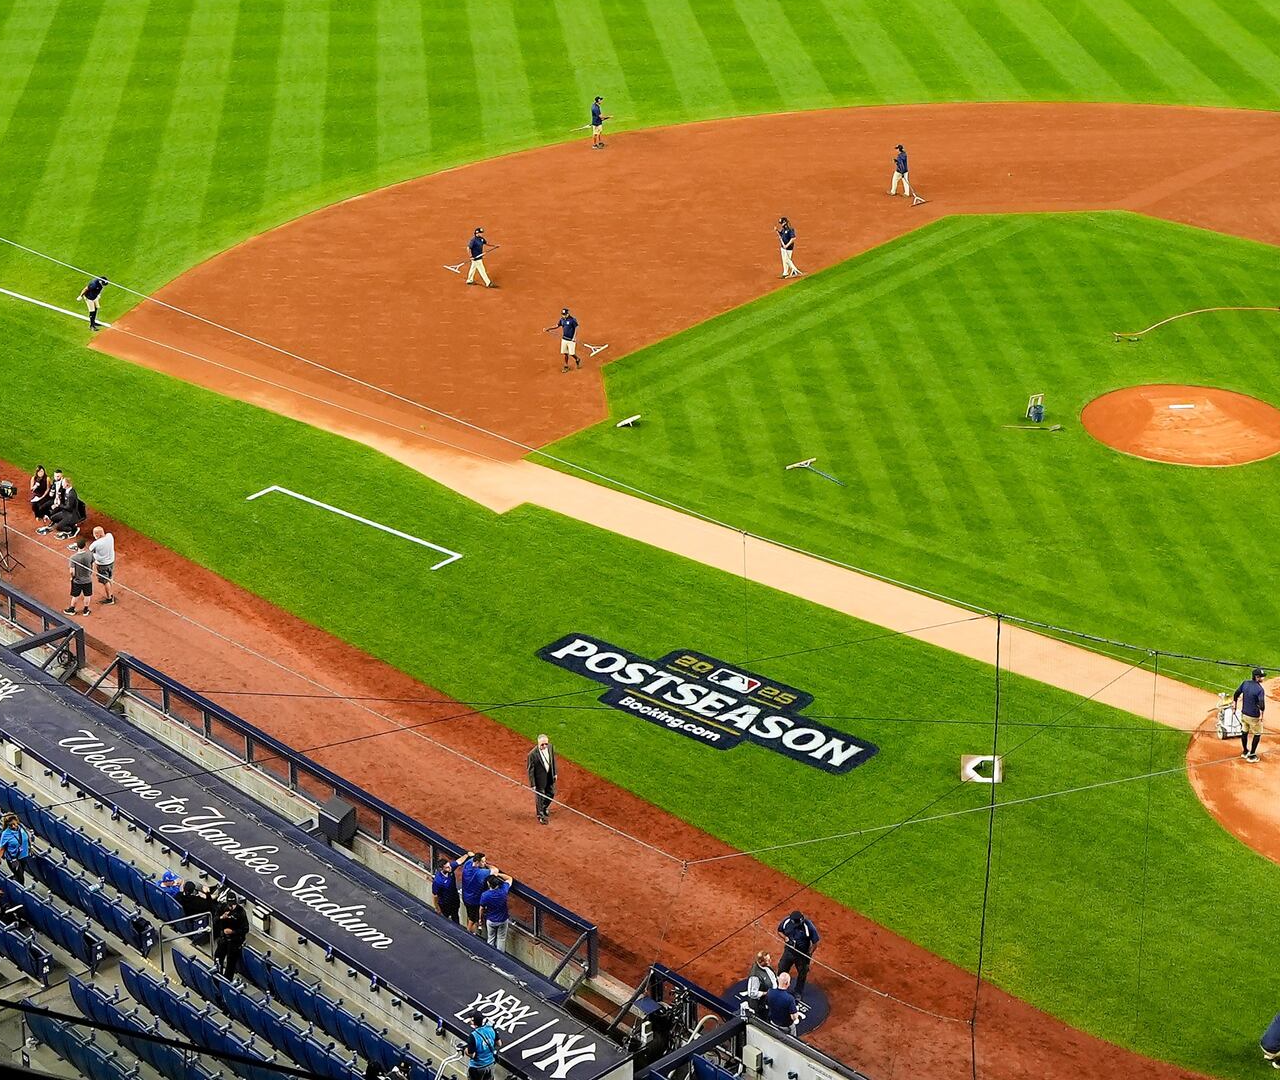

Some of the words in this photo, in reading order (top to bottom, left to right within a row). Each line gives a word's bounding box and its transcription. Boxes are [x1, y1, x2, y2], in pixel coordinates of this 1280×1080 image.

[551, 639, 863, 767] POSTSEASON
[619, 696, 721, 742] Booking.com
[58, 729, 162, 801] Welcome
[159, 796, 188, 815] to
[159, 806, 280, 875] Yankee
[272, 874, 394, 950] Stadium
[468, 993, 528, 1034] YORK
[485, 989, 539, 1020] NEW
